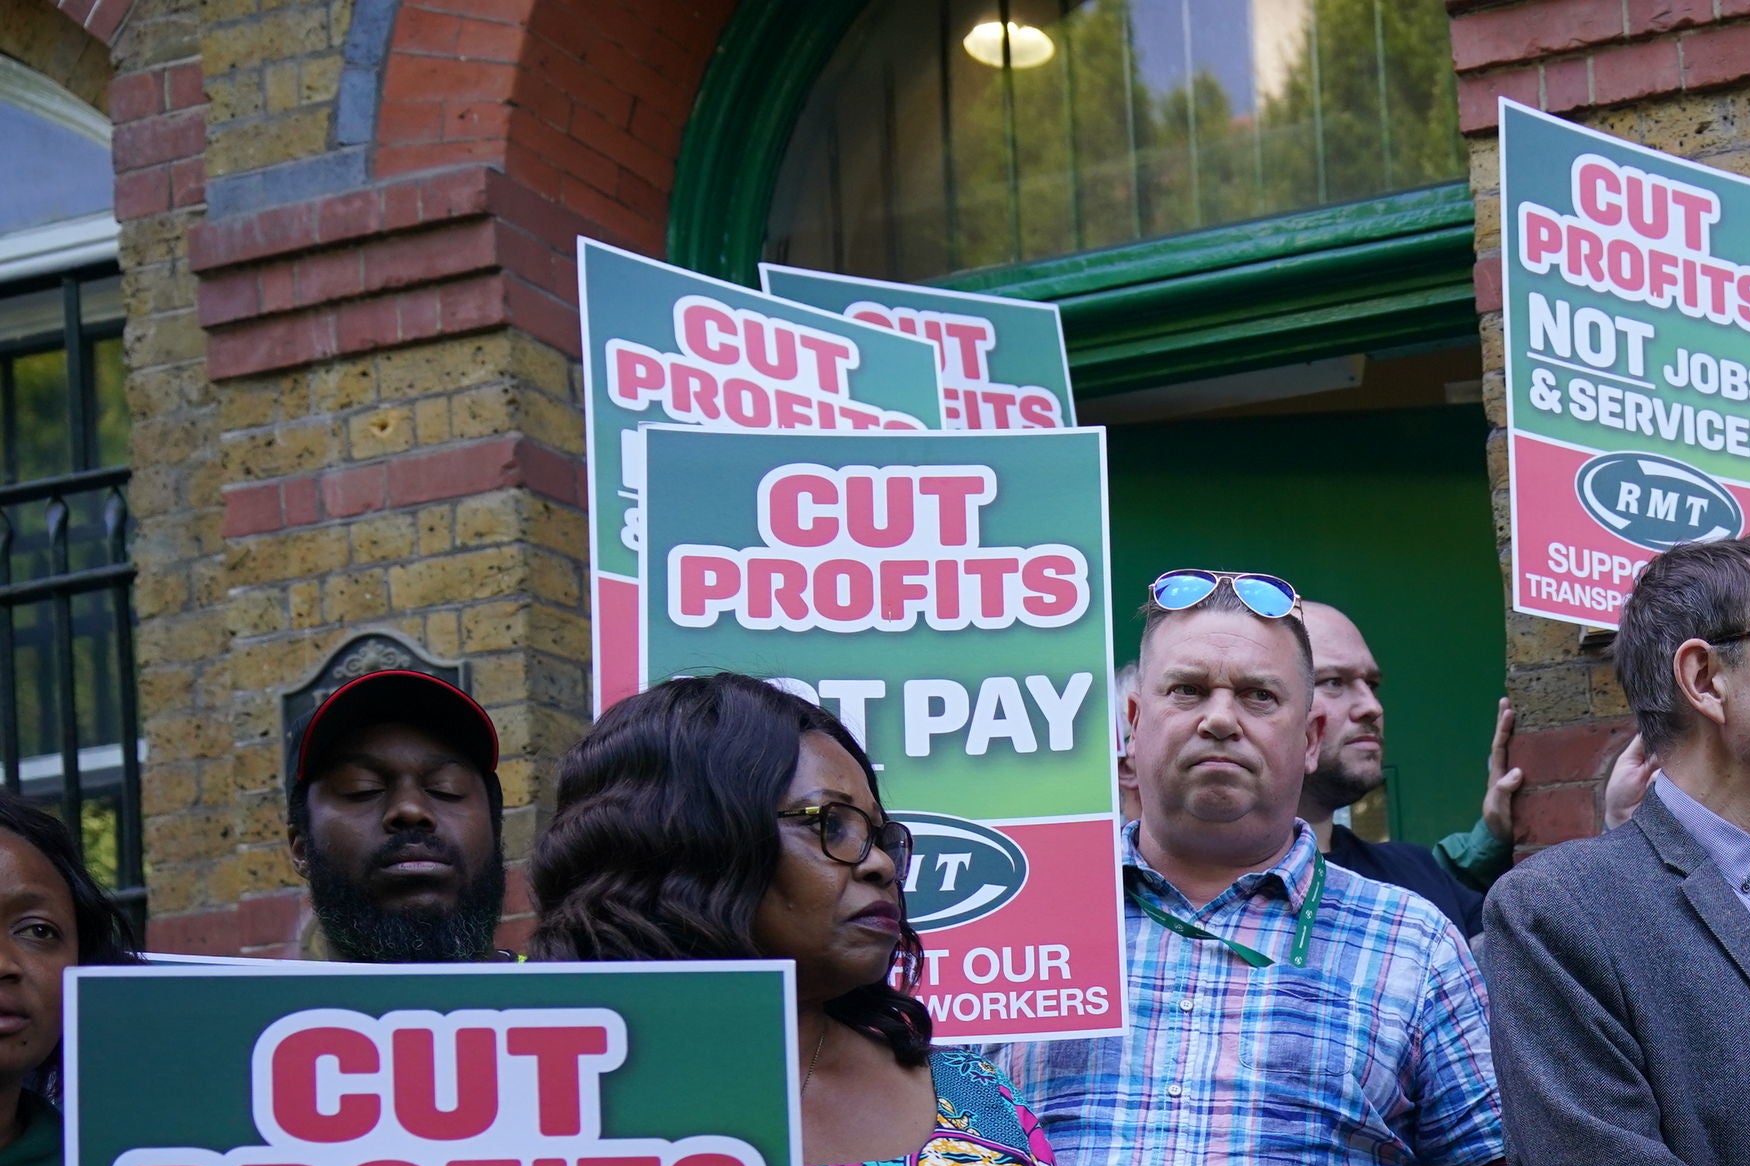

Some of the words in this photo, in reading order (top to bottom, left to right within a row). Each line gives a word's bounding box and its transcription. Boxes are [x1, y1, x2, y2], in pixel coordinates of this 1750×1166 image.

[1579, 163, 1712, 252] CUT
[683, 304, 850, 394] CUT
[1528, 292, 1655, 377] NOT
[616, 348, 919, 429] PROFIT
[1529, 368, 1562, 414] &
[769, 473, 985, 548] CUT
[1615, 481, 1709, 527] RMT
[680, 554, 1078, 622] PROFITS
[1548, 542, 1649, 586] SUPP
[903, 672, 1093, 758] PAY
[963, 944, 1071, 984] OUR
[916, 986, 1109, 1027] WORKERS
[270, 1025, 608, 1144] CUT
